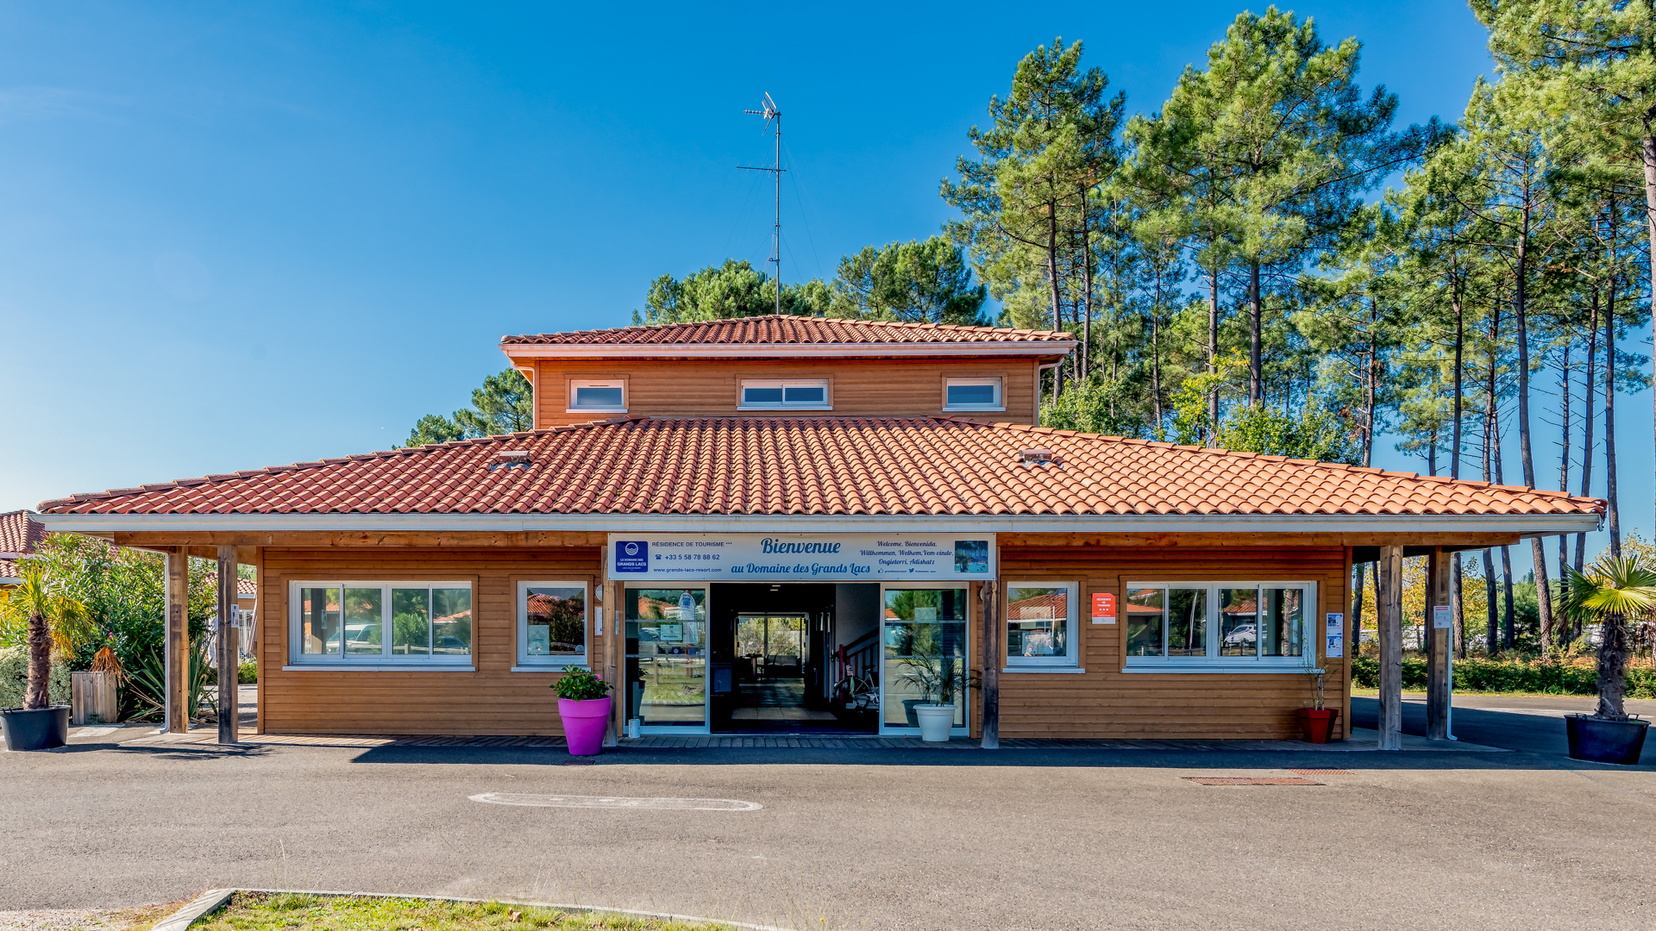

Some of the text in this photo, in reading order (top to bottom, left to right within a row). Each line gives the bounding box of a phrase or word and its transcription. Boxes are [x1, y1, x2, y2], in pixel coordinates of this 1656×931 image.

[760, 538, 841, 554] Bienvenue
[731, 563, 870, 575] au Domaine des Grands Lacs
